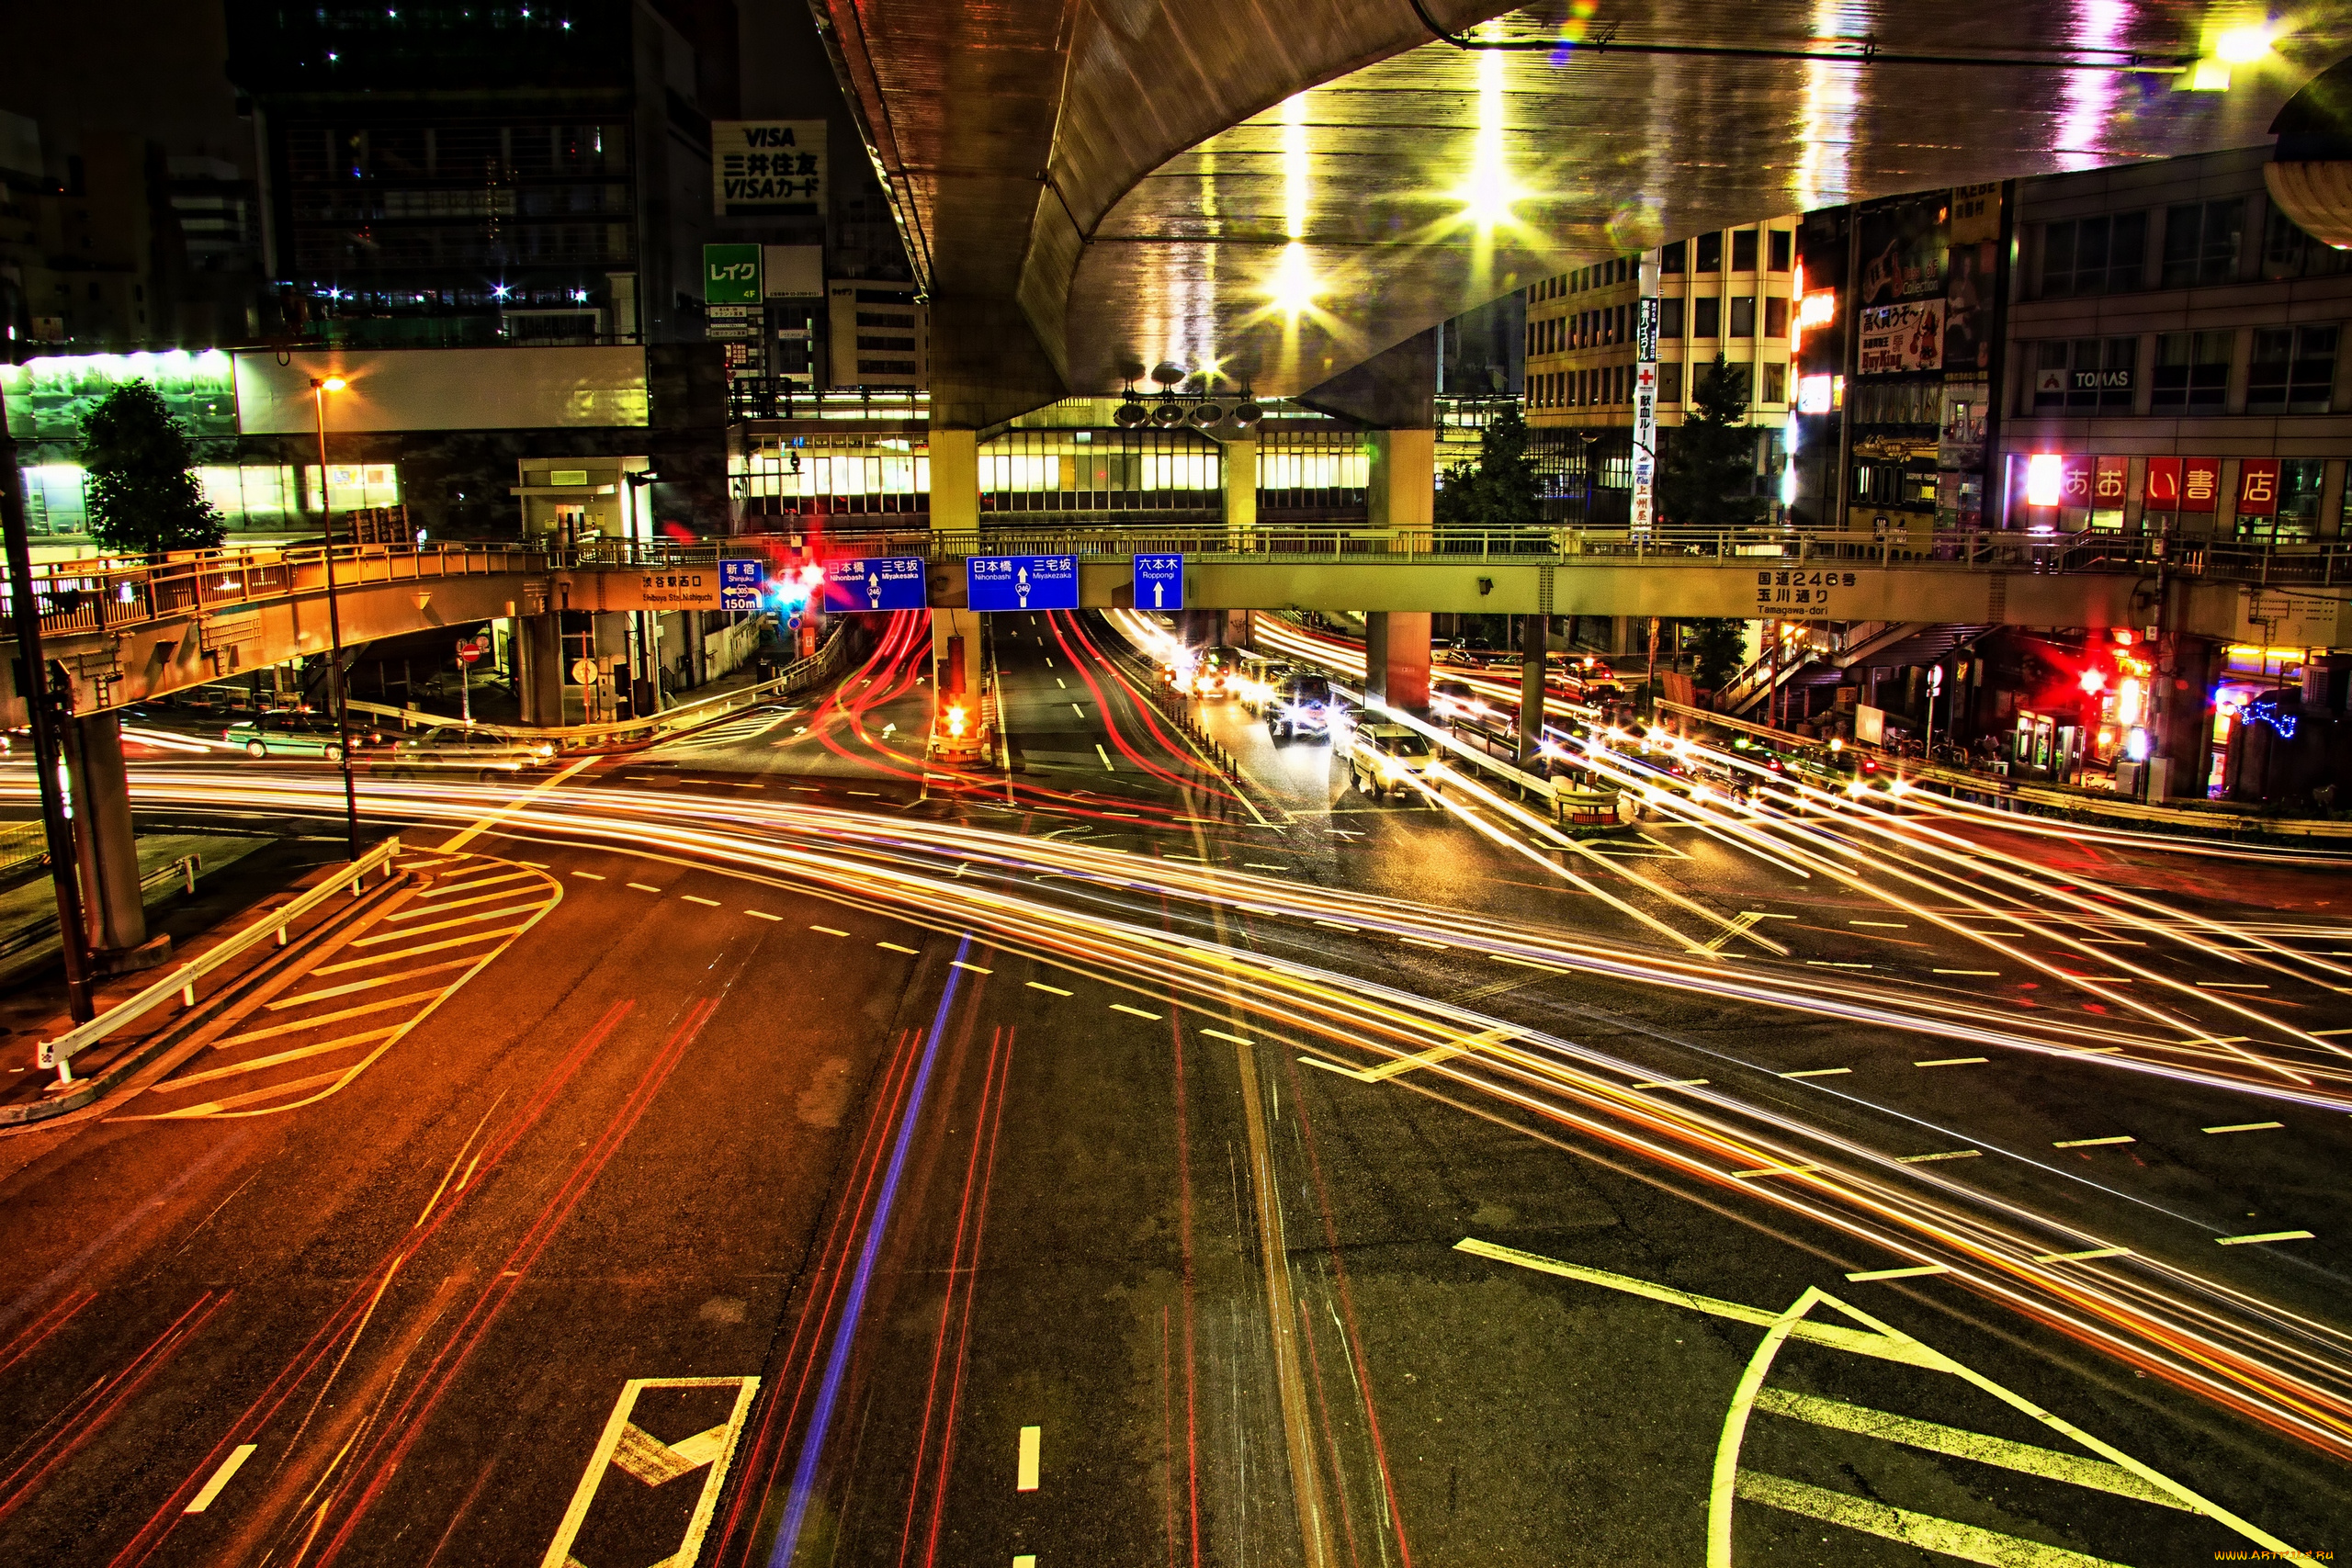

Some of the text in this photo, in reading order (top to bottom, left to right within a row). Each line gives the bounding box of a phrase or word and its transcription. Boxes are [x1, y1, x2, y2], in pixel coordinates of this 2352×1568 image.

[742, 127, 796, 148] VISA
[724, 152, 819, 176] 三井住友
[724, 178, 820, 198] VISAカード
[710, 263, 755, 281] レイク
[1903, 279, 1939, 295] Collection
[743, 290, 756, 299] 4F
[2075, 370, 2129, 388] TOMAS
[2066, 468, 2275, 502] あおい書店
[726, 563, 755, 575] 新宿
[829, 561, 865, 574] 日本橋
[881, 559, 919, 572] 三宅坂
[974, 559, 1012, 573] 日本橋
[1033, 558, 1072, 571] 三宅坂
[1138, 558, 1178, 570] 六本木
[642, 575, 702, 588] 渋谷駅西口
[830, 573, 865, 581] Nihonbashi
[1032, 572, 1072, 581] Miyakezaka
[1142, 571, 1175, 581] Roppongi
[1758, 571, 1857, 587] 国道246号
[1757, 588, 1828, 604] 玉川通り
[725, 599, 755, 608] 150m
[1757, 604, 1828, 616] Tamagawa-dori
